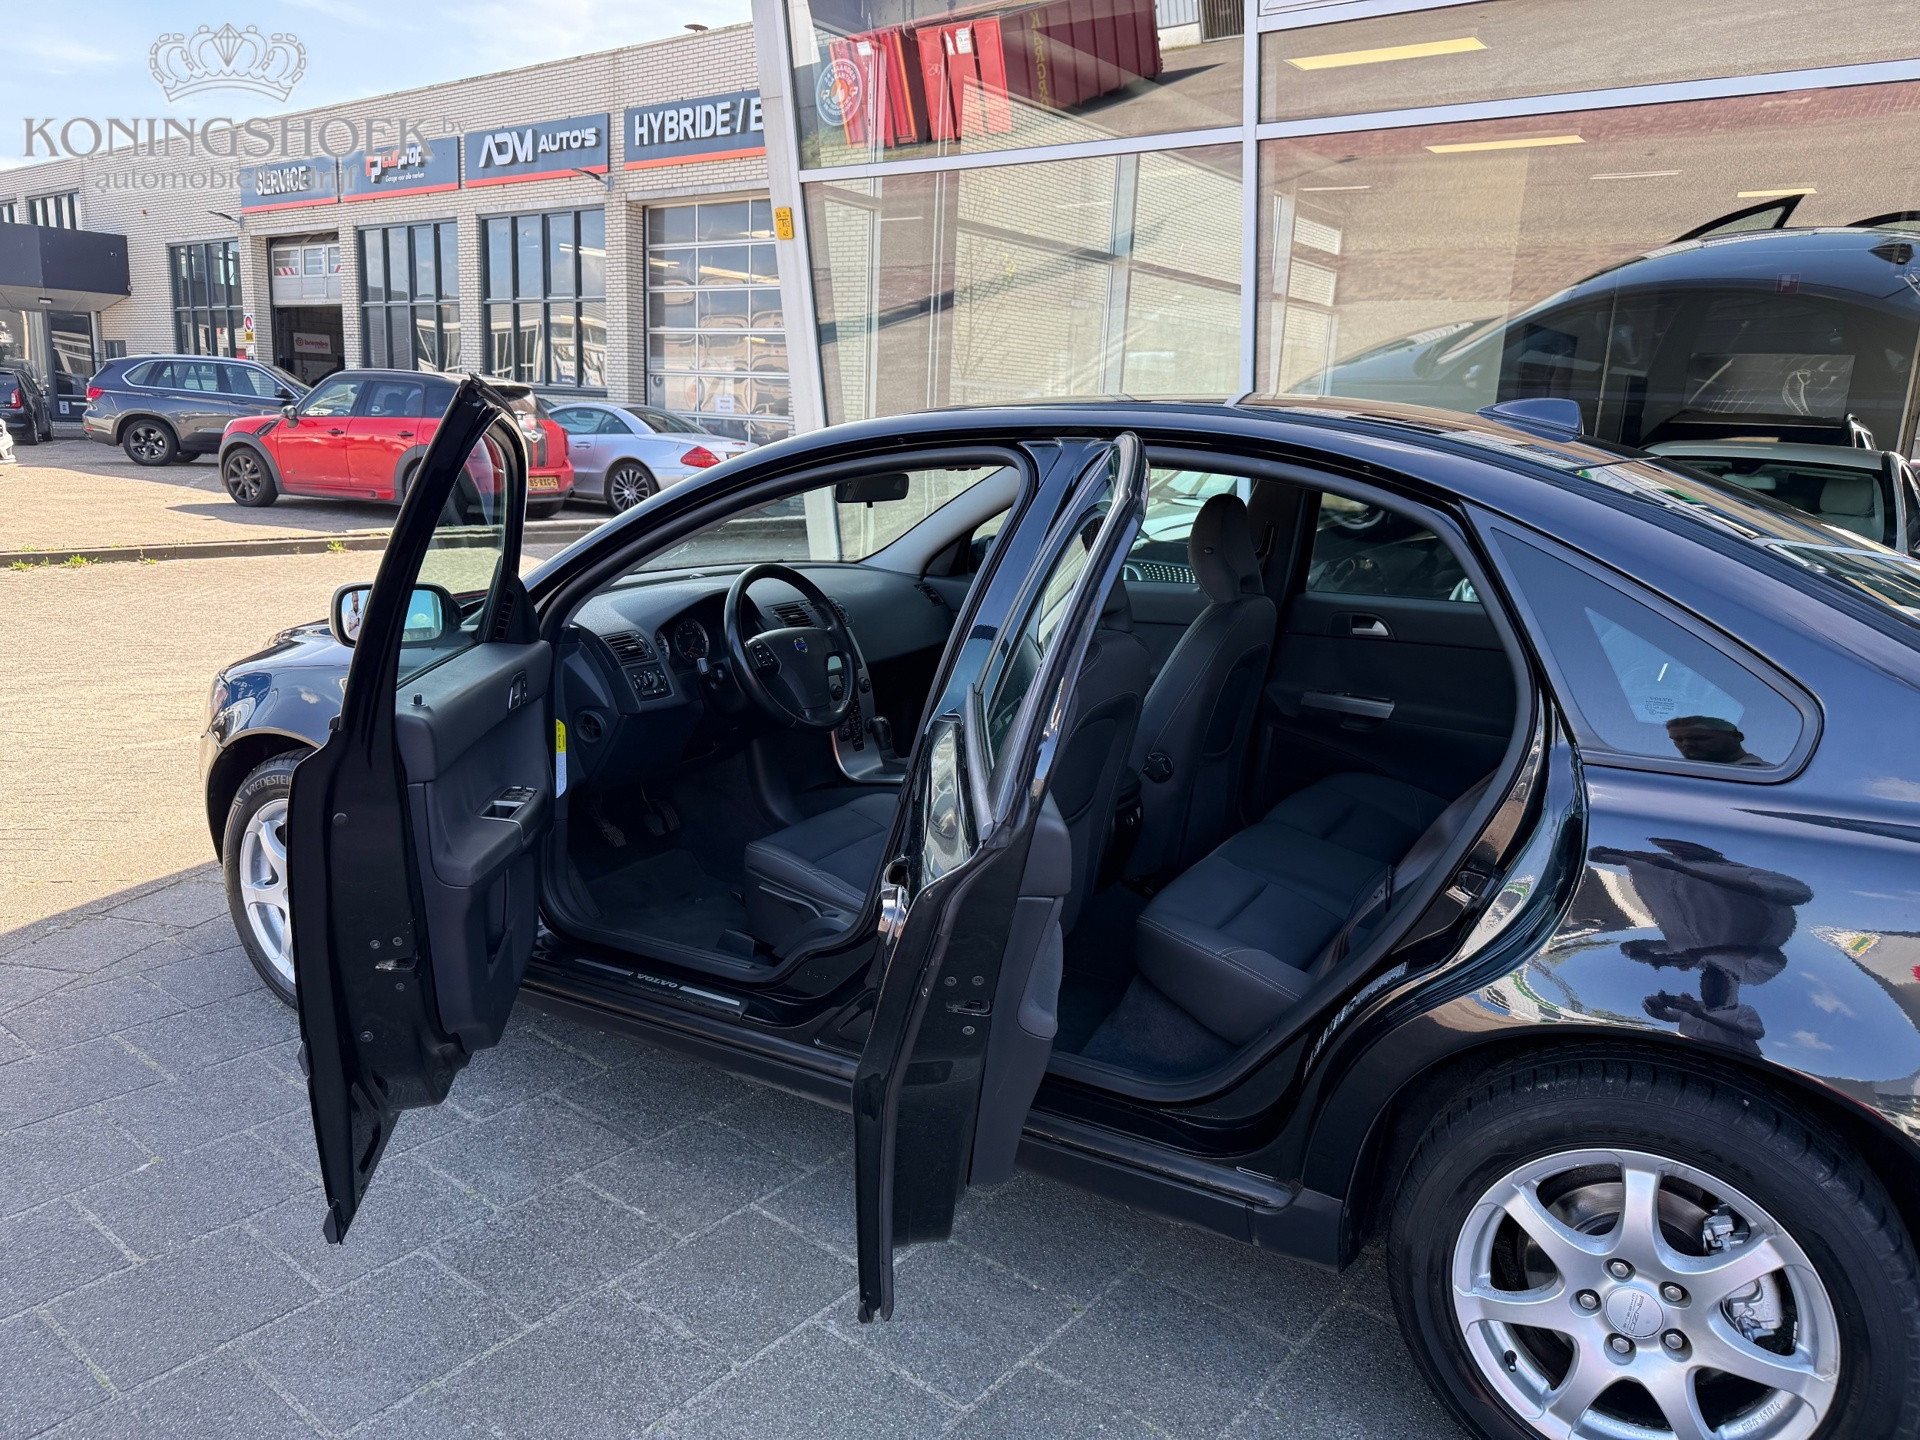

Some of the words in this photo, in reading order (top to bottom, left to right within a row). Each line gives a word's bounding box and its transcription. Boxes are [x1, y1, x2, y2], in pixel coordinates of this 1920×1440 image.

[634, 101, 731, 147] HYBRIDE
[479, 129, 534, 168] ADM
[538, 127, 598, 153] AUTO'S
[255, 166, 307, 195] SERVICE
[245, 774, 289, 796] VREDESTEI
[637, 973, 678, 988] VOLVO
